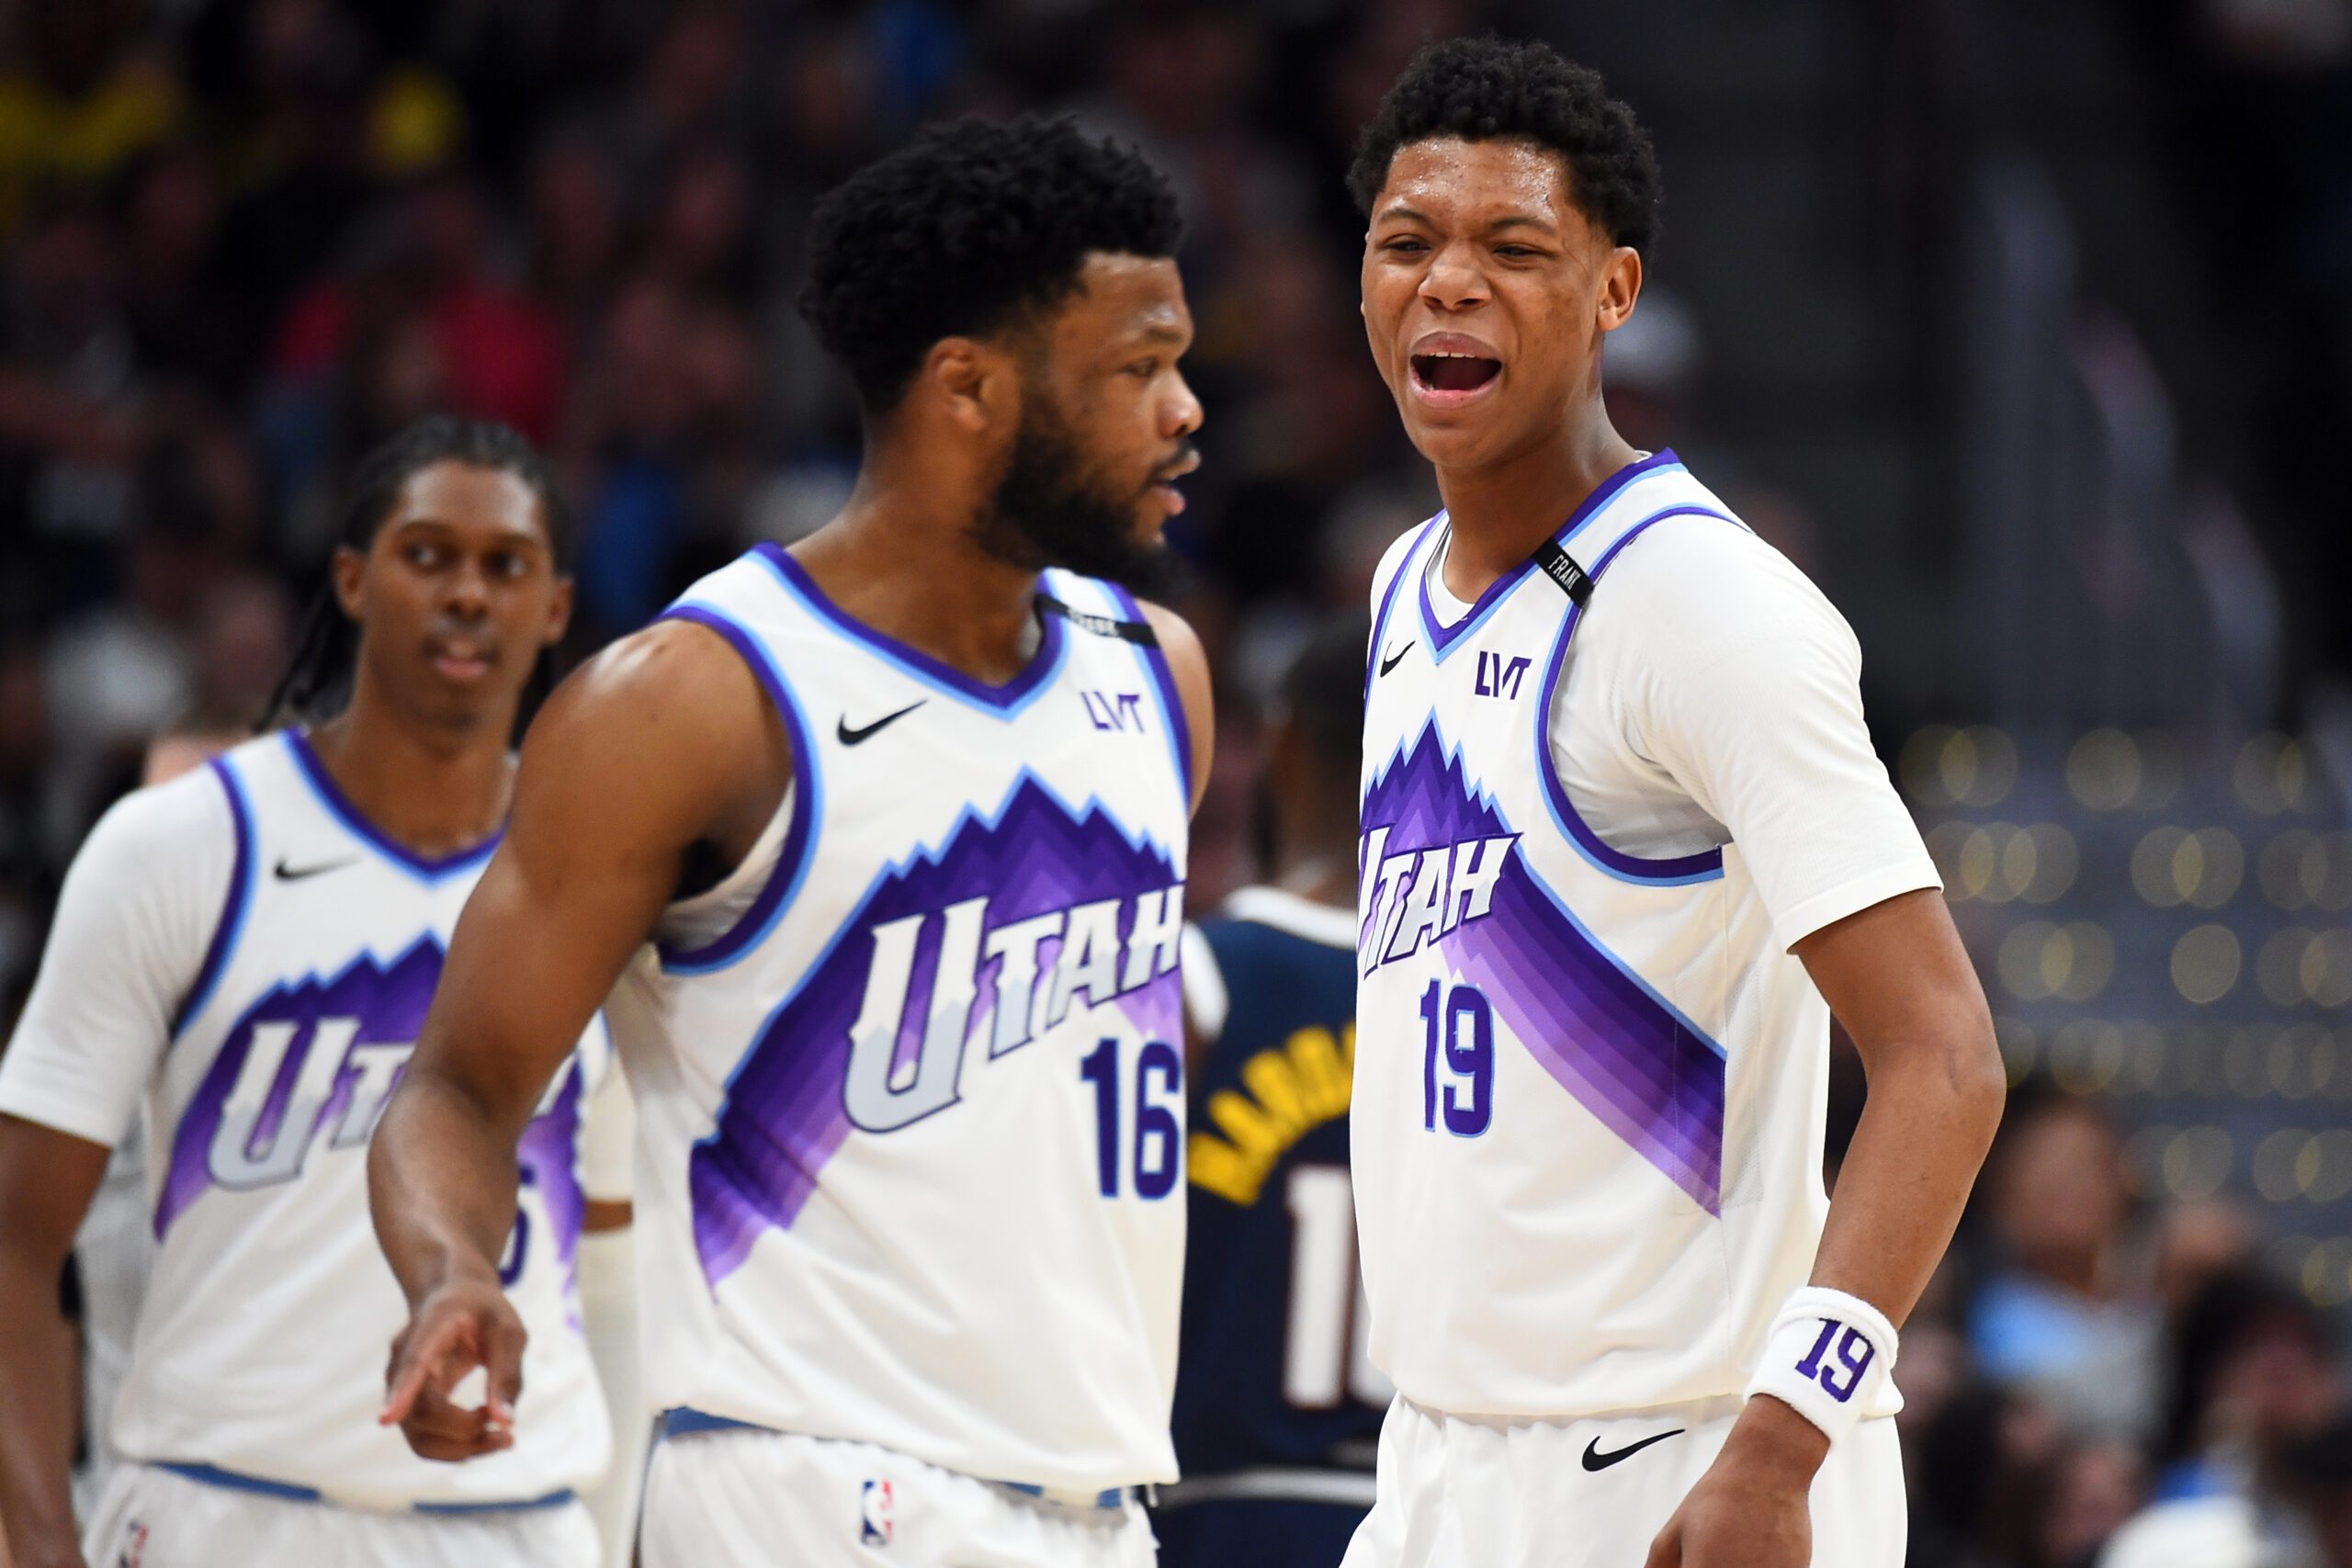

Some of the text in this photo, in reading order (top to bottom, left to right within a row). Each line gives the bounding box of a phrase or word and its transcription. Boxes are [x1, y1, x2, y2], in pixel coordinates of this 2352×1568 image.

[1547, 555, 1581, 591] FRANK
[1475, 650, 1532, 700] LVT
[842, 878, 1186, 1134] UTAH
[1419, 976, 1494, 1138] 19
[1080, 1037, 1183, 1201] 16
[1794, 1316, 1876, 1404] 19
